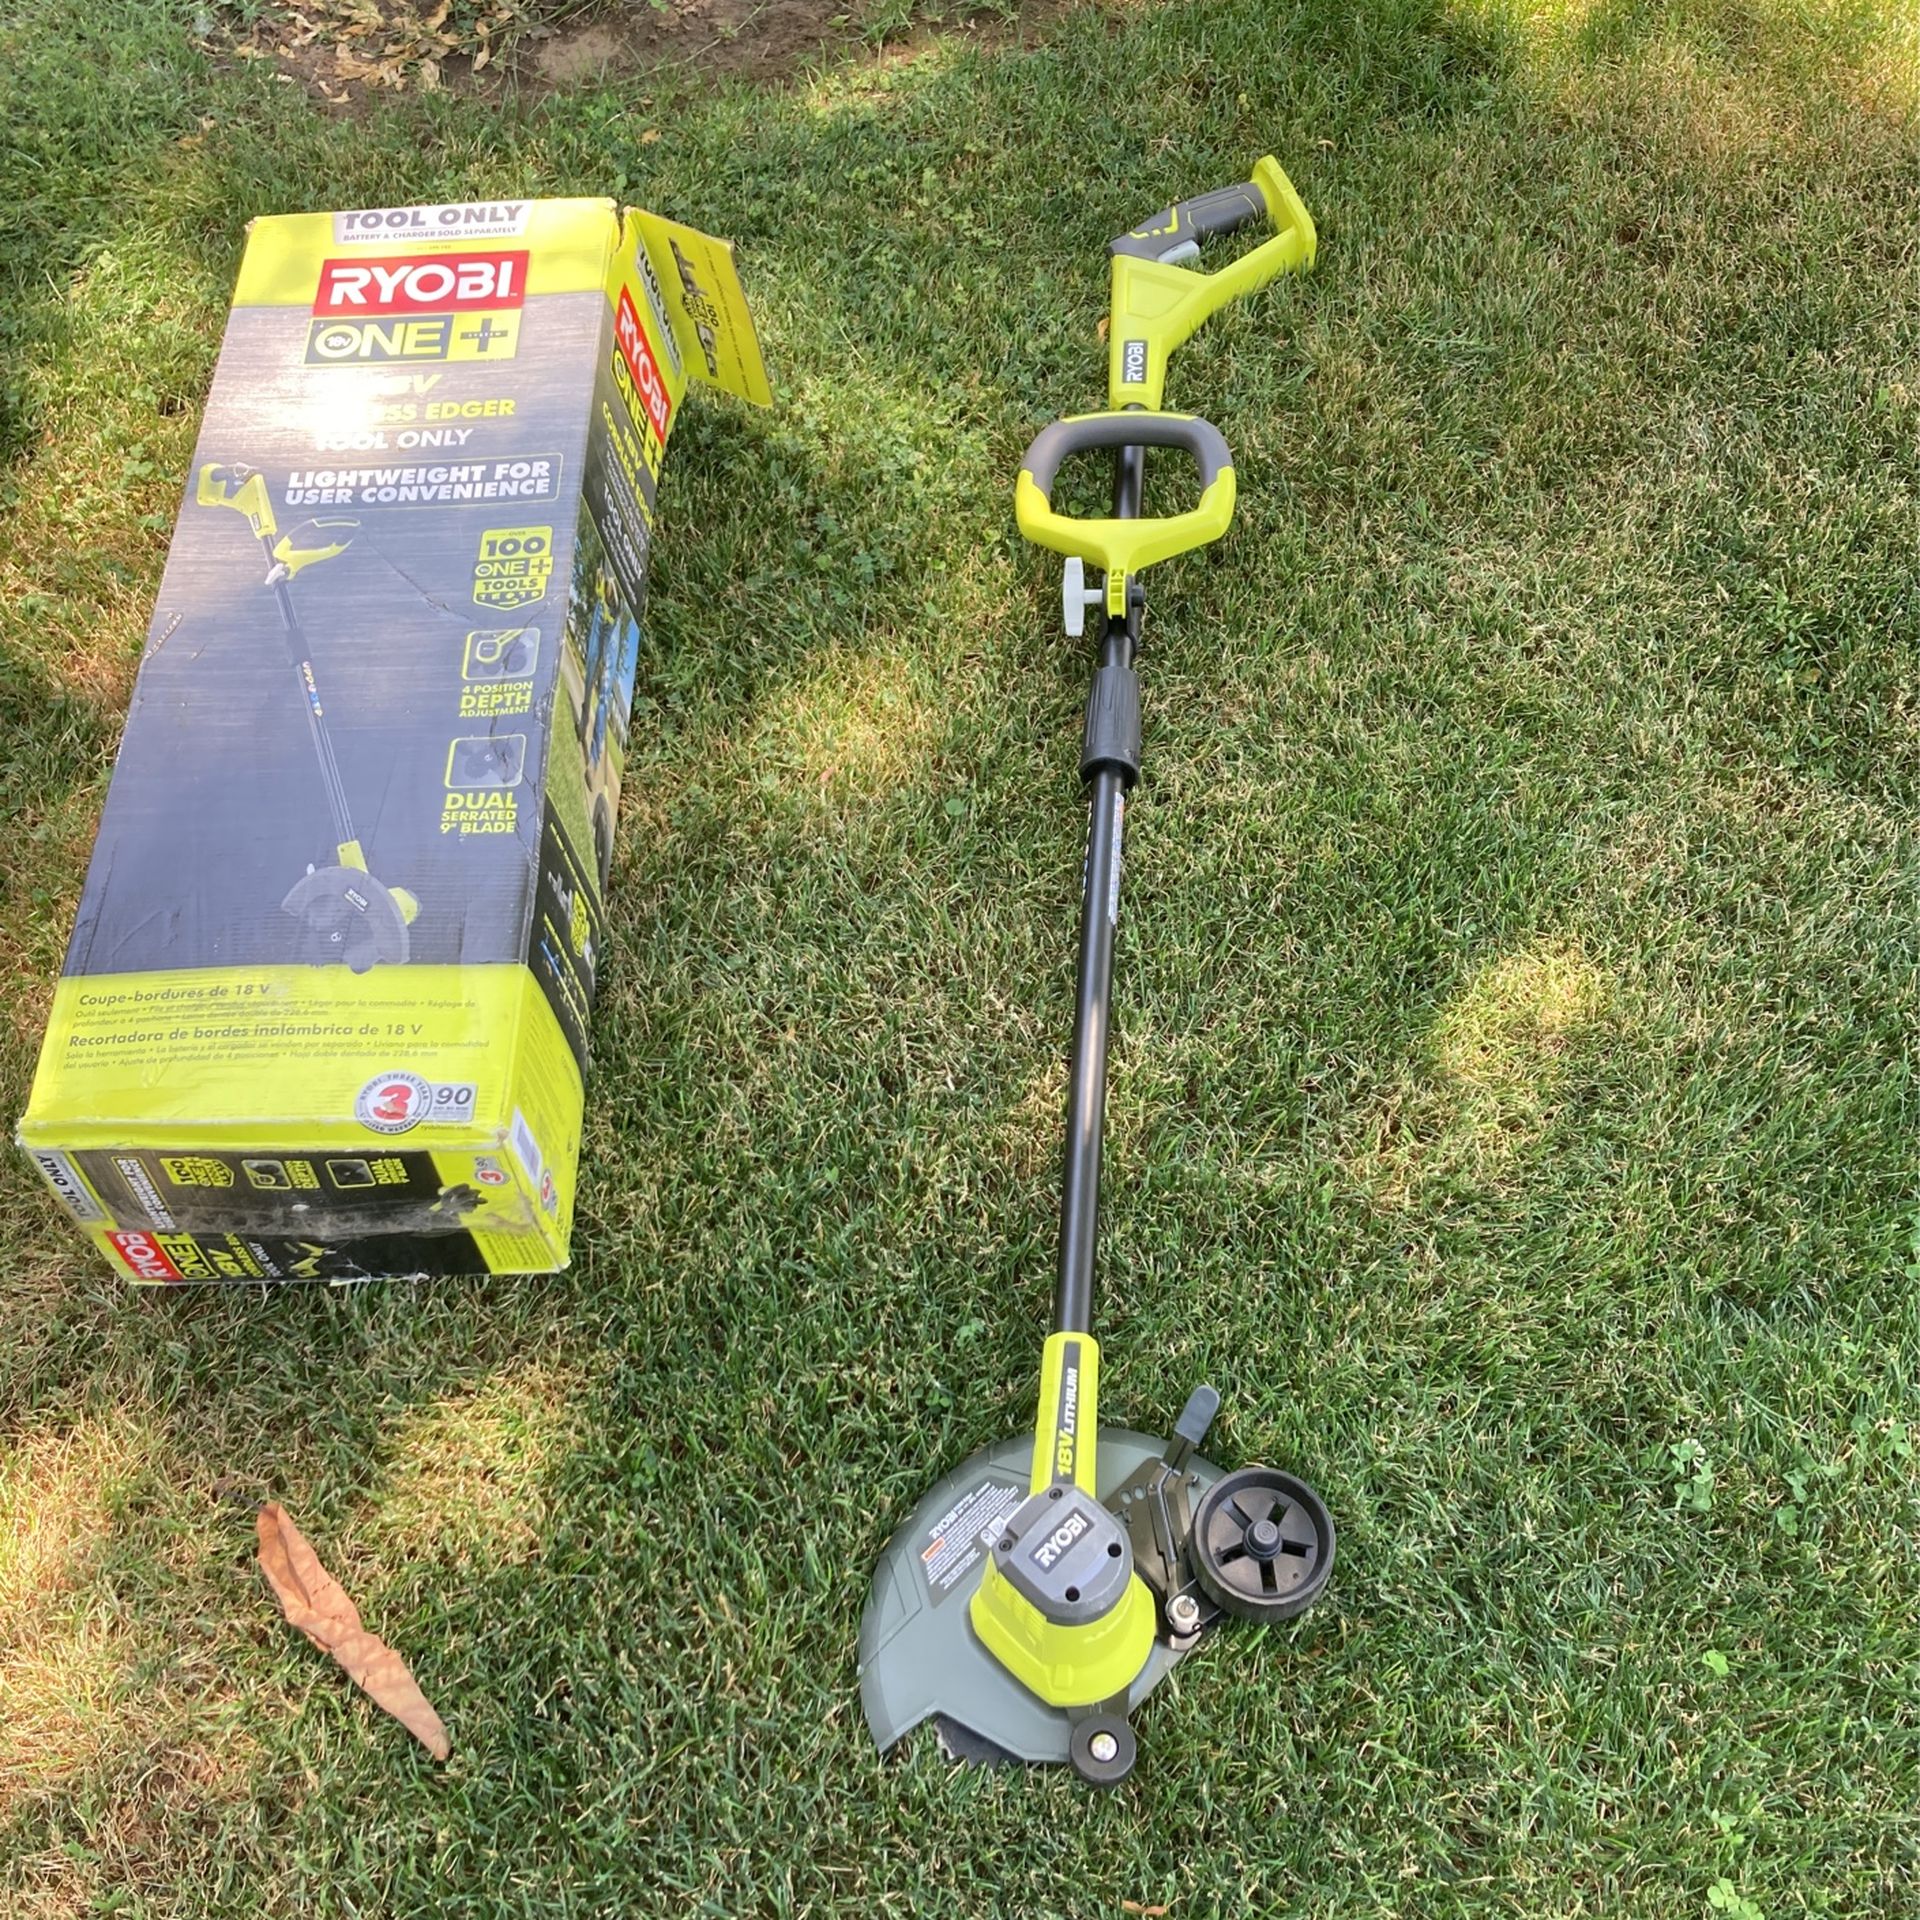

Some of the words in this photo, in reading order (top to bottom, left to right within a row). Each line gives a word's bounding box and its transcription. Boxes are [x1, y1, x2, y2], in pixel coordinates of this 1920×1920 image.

[345, 211, 426, 229] TOOL
[438, 205, 524, 224] ONLY
[343, 233, 381, 241] BATTERY
[393, 230, 436, 239] CHARGER
[437, 229, 462, 237] SOLD
[464, 226, 517, 235] SEPARATELY
[329, 261, 514, 305] RYOBI
[707, 303, 720, 328] 100
[620, 297, 669, 433] RYOBI
[1127, 342, 1144, 381] RYOBI
[425, 399, 516, 420] EDGER
[314, 431, 389, 451] TOOL
[397, 429, 474, 448] ONLY
[288, 465, 486, 489] LIGHTWEIGHT
[494, 461, 551, 480] FOR
[285, 489, 353, 505] USER
[361, 478, 550, 503] CONVENIENCE
[604, 482, 623, 537] TOOL
[487, 536, 545, 556] 100
[484, 577, 538, 590] TOOLS
[460, 690, 532, 709] DEPTH
[462, 685, 471, 694] 4
[474, 681, 533, 693] POSITION
[458, 705, 530, 718] ADJUSTMENT
[444, 792, 519, 810] DUAL
[441, 810, 517, 822] SERRATED
[460, 821, 516, 833] BLADE
[79, 988, 204, 1007] Coupe-bordures
[209, 985, 229, 997] de
[235, 984, 254, 996] 18
[259, 983, 271, 995] V
[69, 1031, 164, 1047] Recortadora
[169, 1027, 189, 1041] de
[194, 1025, 249, 1039] bordes
[254, 1023, 352, 1037] inalámbrica
[359, 1023, 380, 1036] de
[386, 1023, 405, 1036] 18
[411, 1023, 423, 1036] V
[372, 1084, 413, 1120] 3
[435, 1087, 473, 1105] 90
[37, 1155, 69, 1187] ONLY
[170, 1160, 193, 1183] 100
[370, 1160, 387, 1185] DUAL
[207, 1248, 247, 1277] 18V
[929, 1510, 959, 1539] RYOBI
[1034, 1512, 1089, 1568] RYOBI
